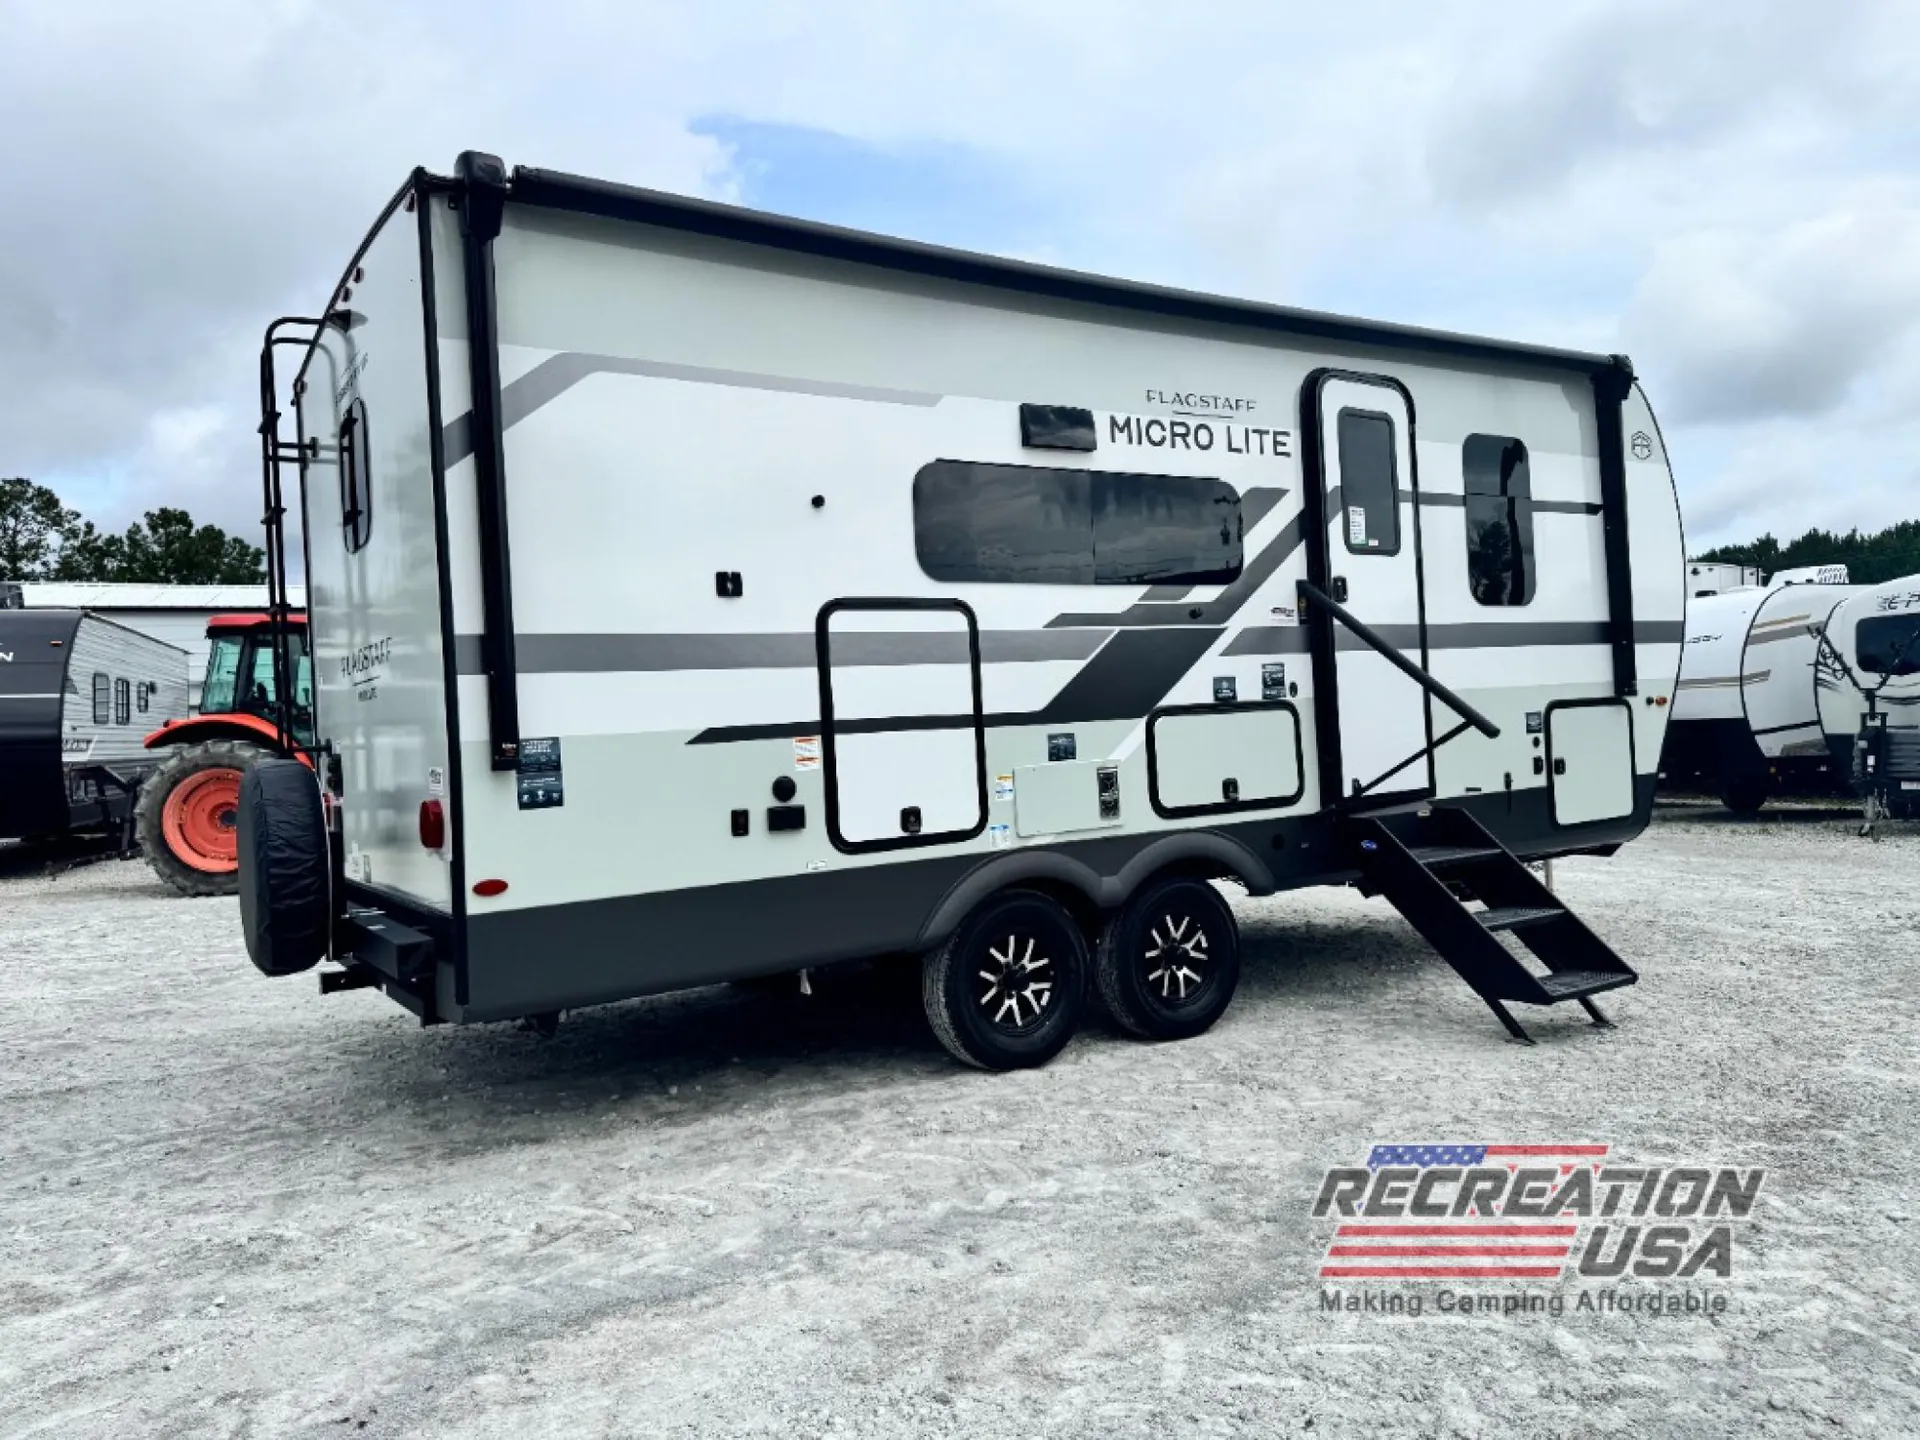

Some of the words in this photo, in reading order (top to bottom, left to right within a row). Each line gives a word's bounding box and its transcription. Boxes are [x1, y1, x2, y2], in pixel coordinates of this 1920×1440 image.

[1146, 389, 1256, 412] FLAGSTAFF
[1110, 414, 1214, 451] MICRO
[1226, 425, 1291, 457] LITE
